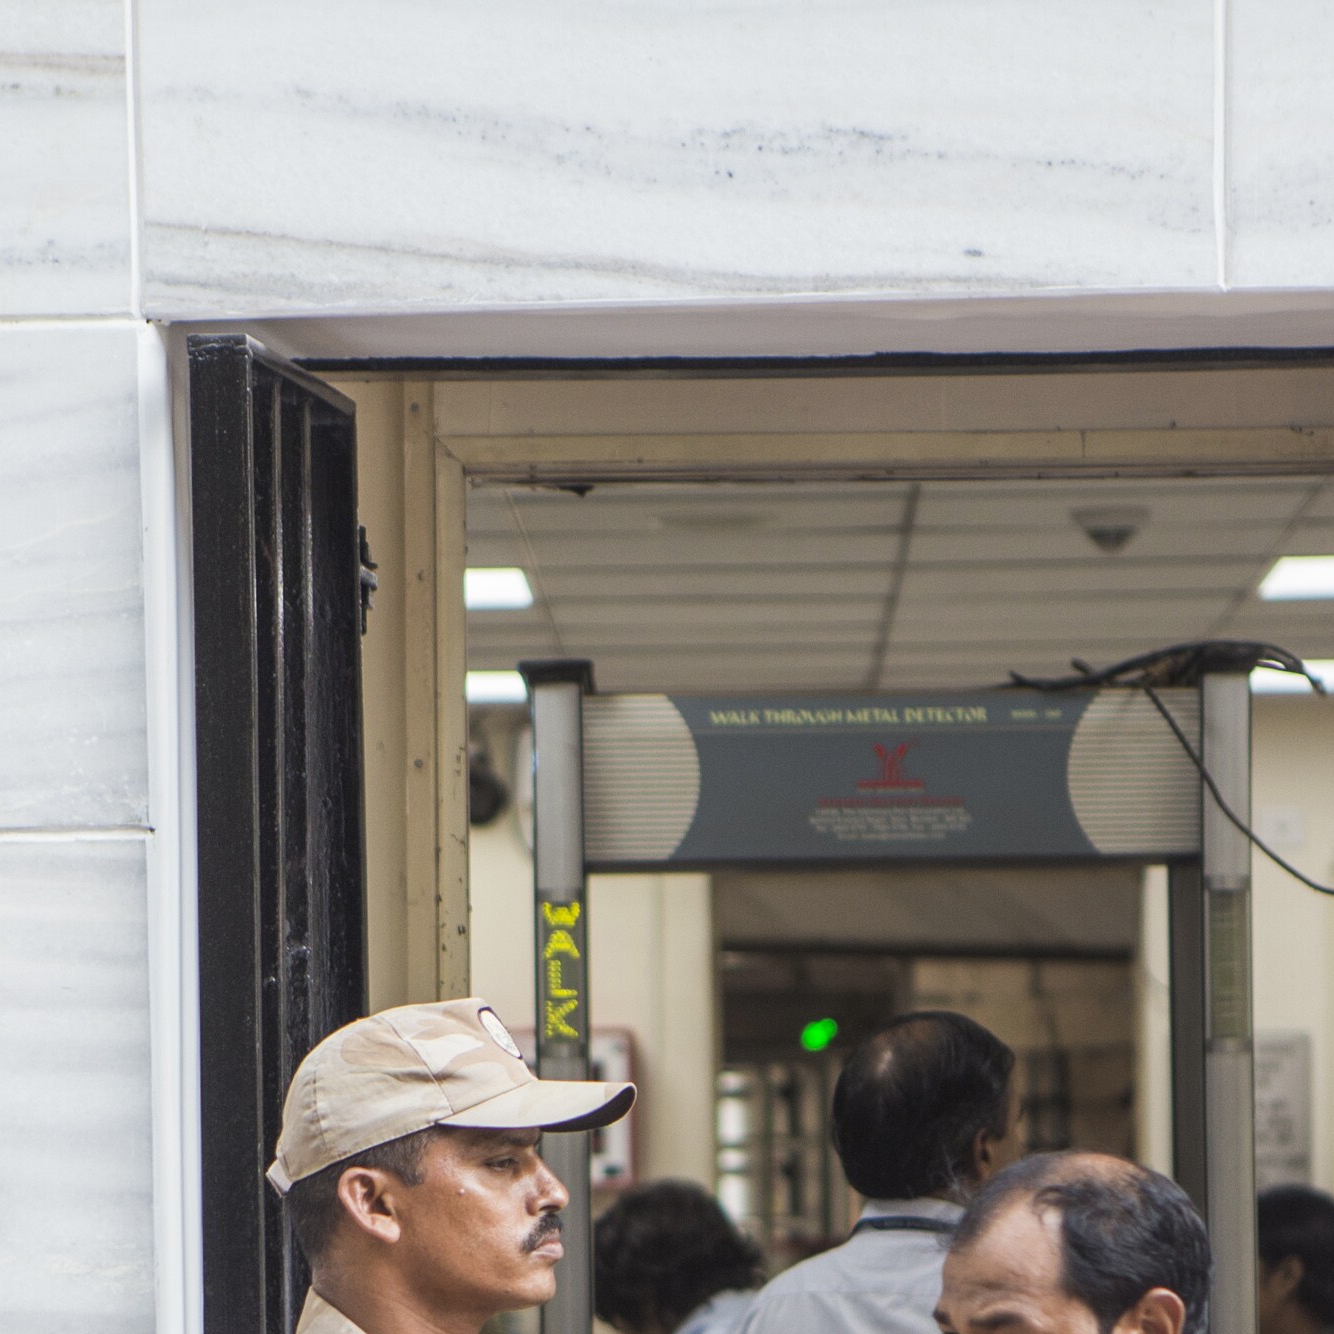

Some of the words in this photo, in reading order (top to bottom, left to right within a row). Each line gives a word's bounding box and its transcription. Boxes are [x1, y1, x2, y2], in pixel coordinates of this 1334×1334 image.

[710, 709, 760, 725] WALK
[764, 708, 842, 724] THROUGH
[845, 707, 901, 723] METAL
[904, 706, 987, 722] DETECTOR
[542, 902, 581, 1038] WALK
